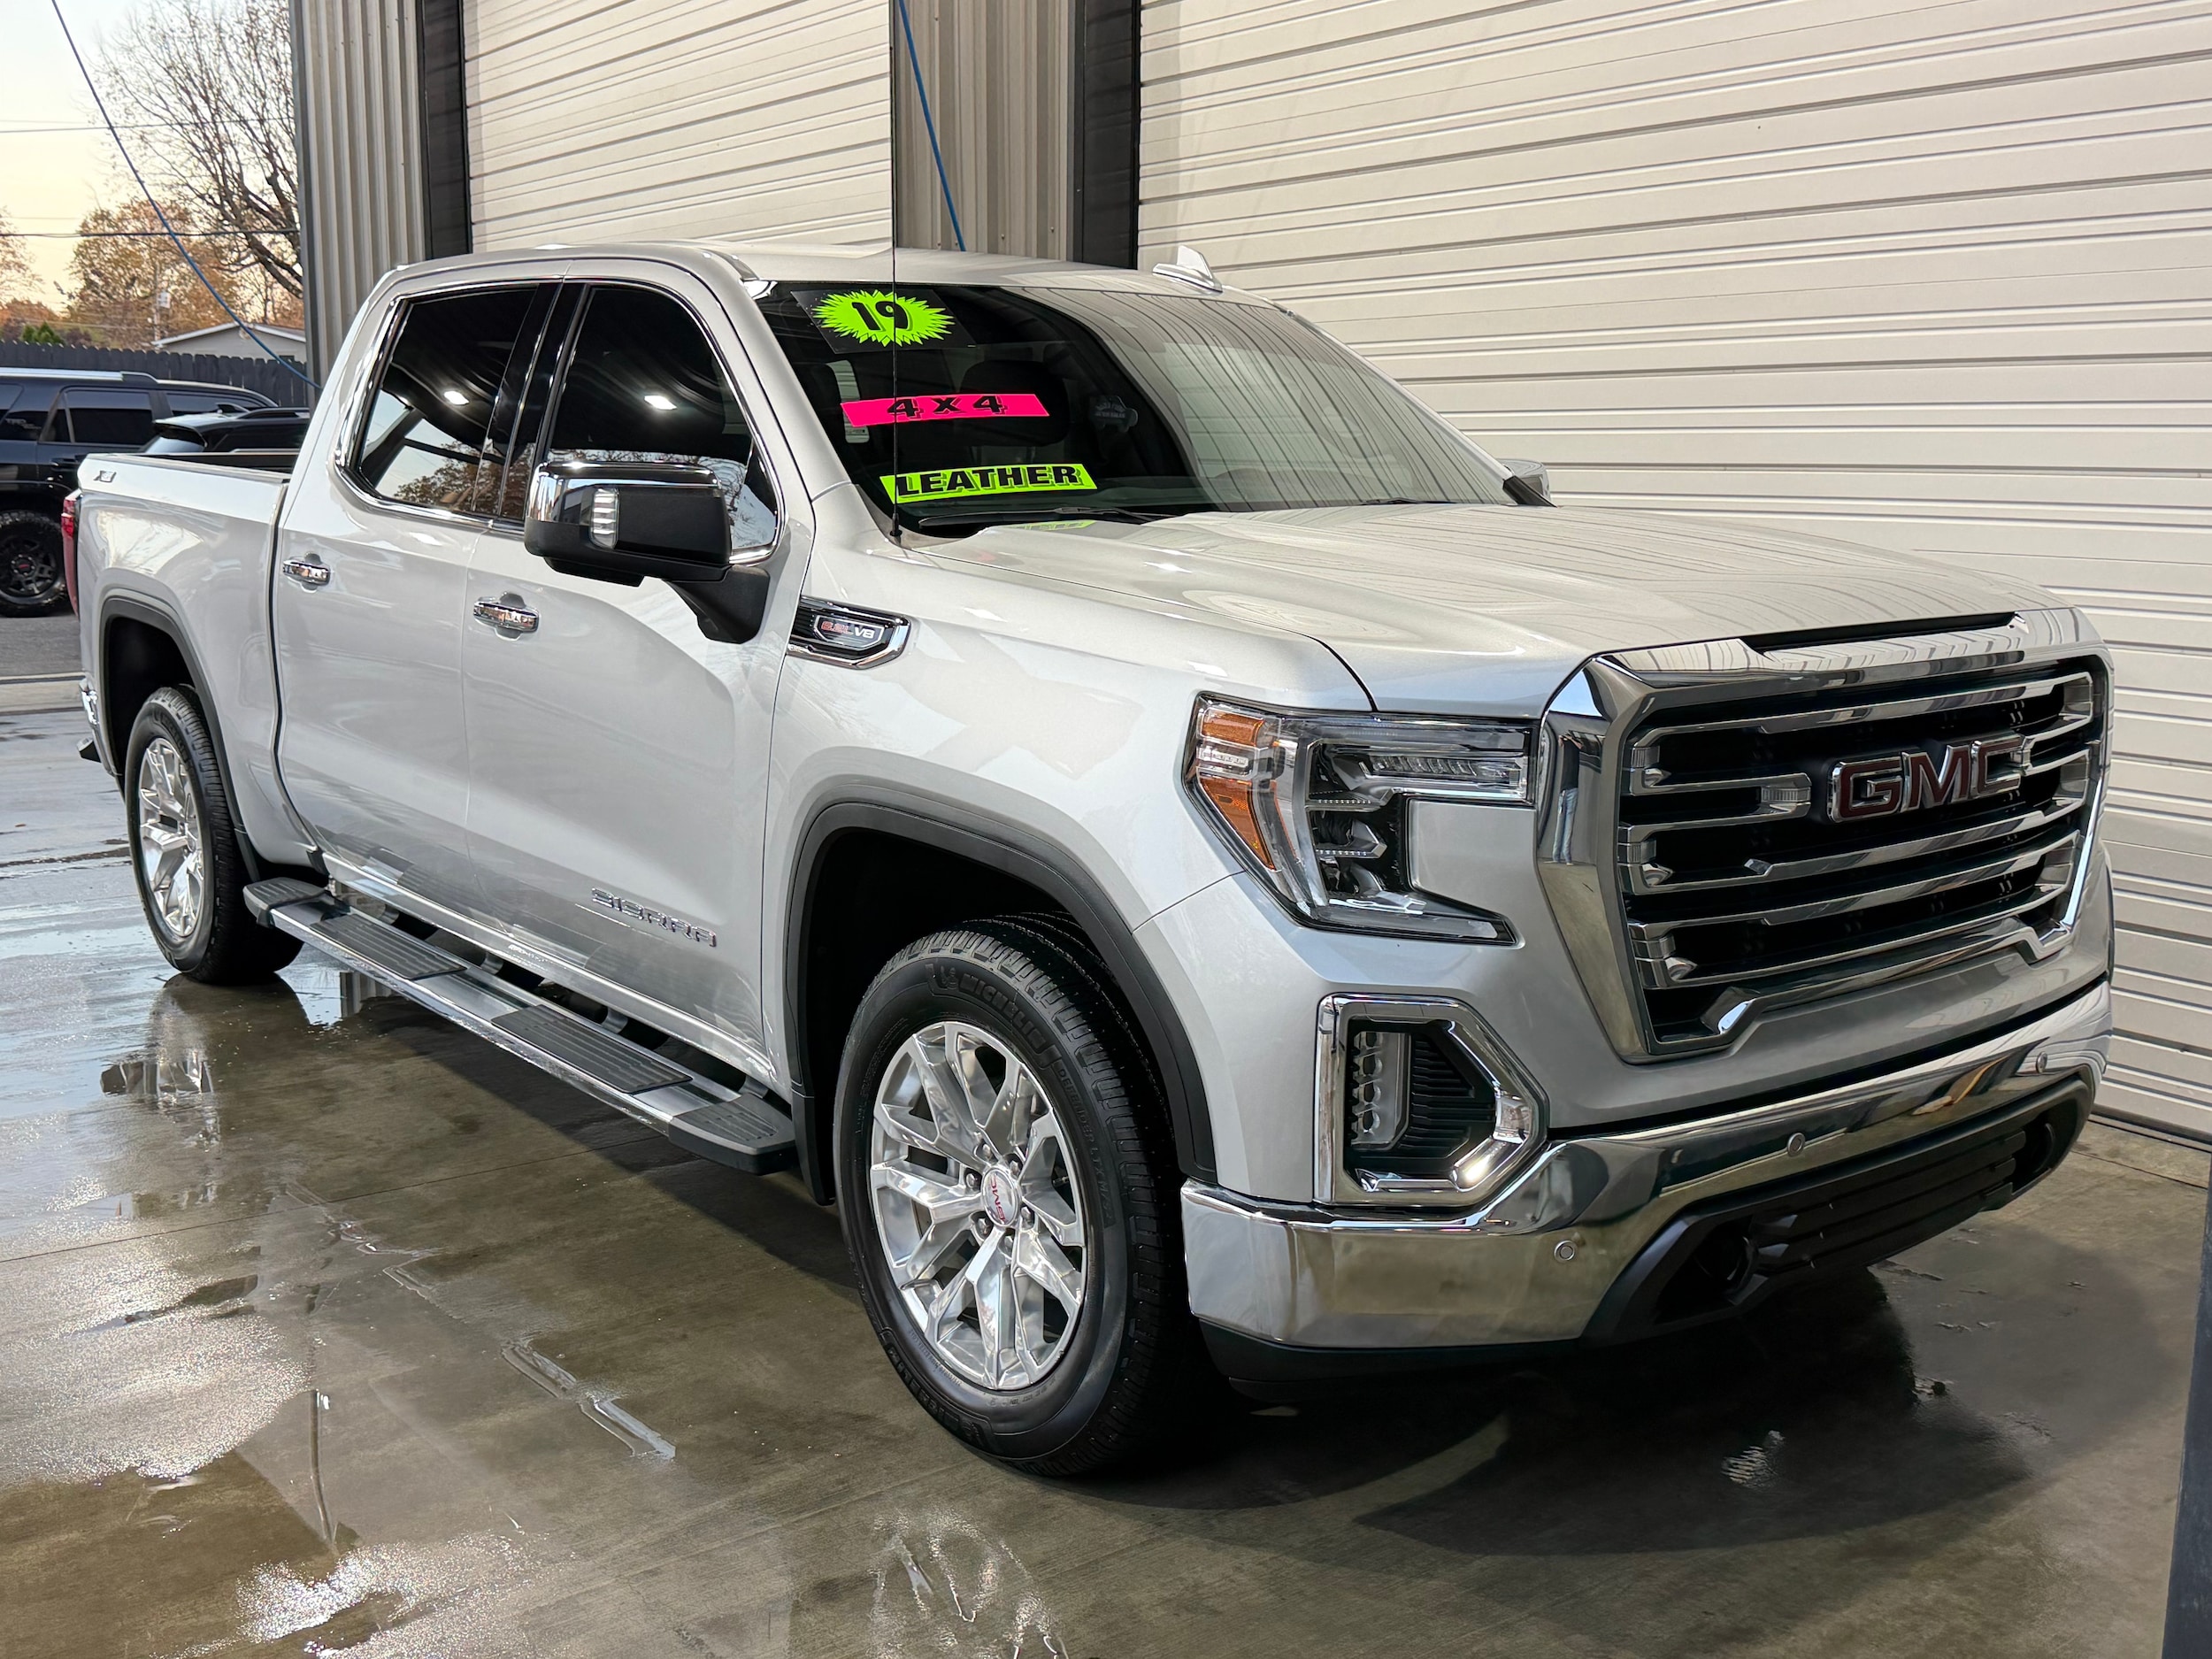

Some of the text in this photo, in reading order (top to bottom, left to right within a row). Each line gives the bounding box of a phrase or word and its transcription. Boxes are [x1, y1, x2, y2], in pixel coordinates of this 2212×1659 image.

[850, 301, 912, 333] 19
[895, 465, 1081, 497] LEATHER
[854, 626, 876, 639] V8
[1828, 735, 2024, 824] GMC
[591, 887, 718, 948] SIERRA
[959, 972, 1048, 1050] MICHELIN
[990, 1172, 1007, 1224] GMC
